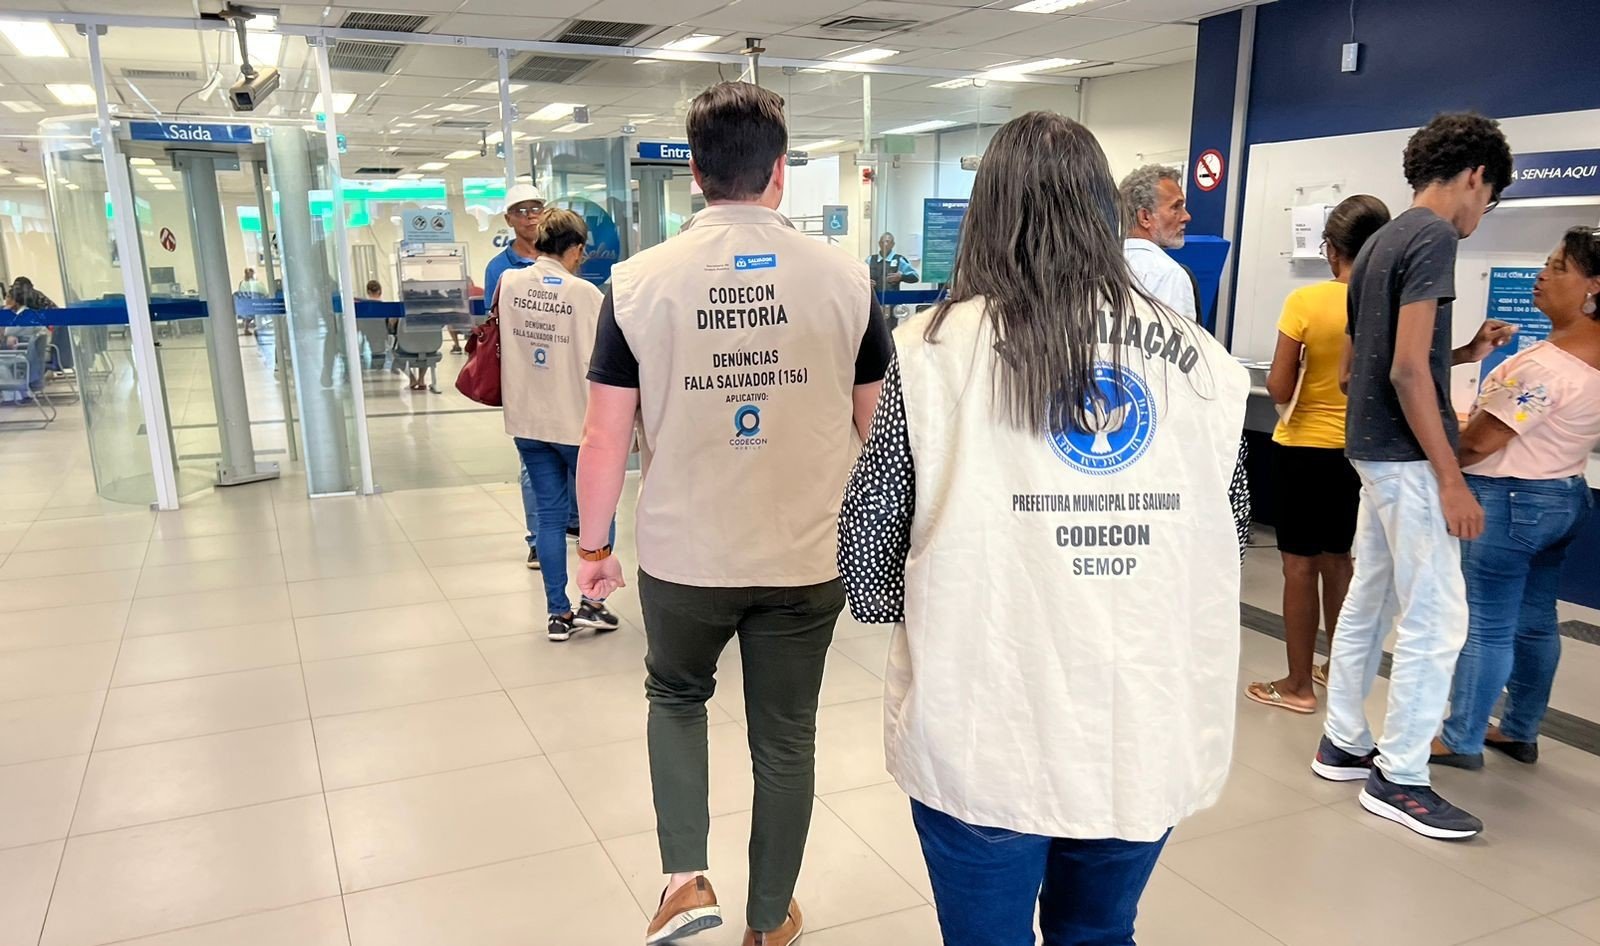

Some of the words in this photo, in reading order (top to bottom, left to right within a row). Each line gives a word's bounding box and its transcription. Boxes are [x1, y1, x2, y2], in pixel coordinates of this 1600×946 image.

[169, 124, 212, 141] Saída
[660, 144, 692, 159] Entra
[1520, 167, 1561, 180] SENHA
[1562, 165, 1597, 179] AQUI
[527, 288, 559, 301] CODECON
[709, 284, 775, 304] CODECON
[513, 297, 573, 316] FISCALIZAÇÃO
[696, 304, 789, 330] DIRETORIA
[712, 348, 779, 368] DENÚNCIAS
[684, 375, 714, 390] FALA
[716, 371, 775, 389] SALVADOR
[778, 367, 808, 386] (156)
[725, 392, 769, 403] APLICATIVO:
[729, 438, 768, 446] CODECON
[1012, 494, 1070, 512] PREFEITURA
[1073, 493, 1126, 512] MUNICIPAL
[1128, 493, 1141, 511] DE
[1142, 492, 1181, 511] SALVADOR
[1056, 524, 1150, 547] CODECON
[1072, 557, 1137, 576] SEMOP
